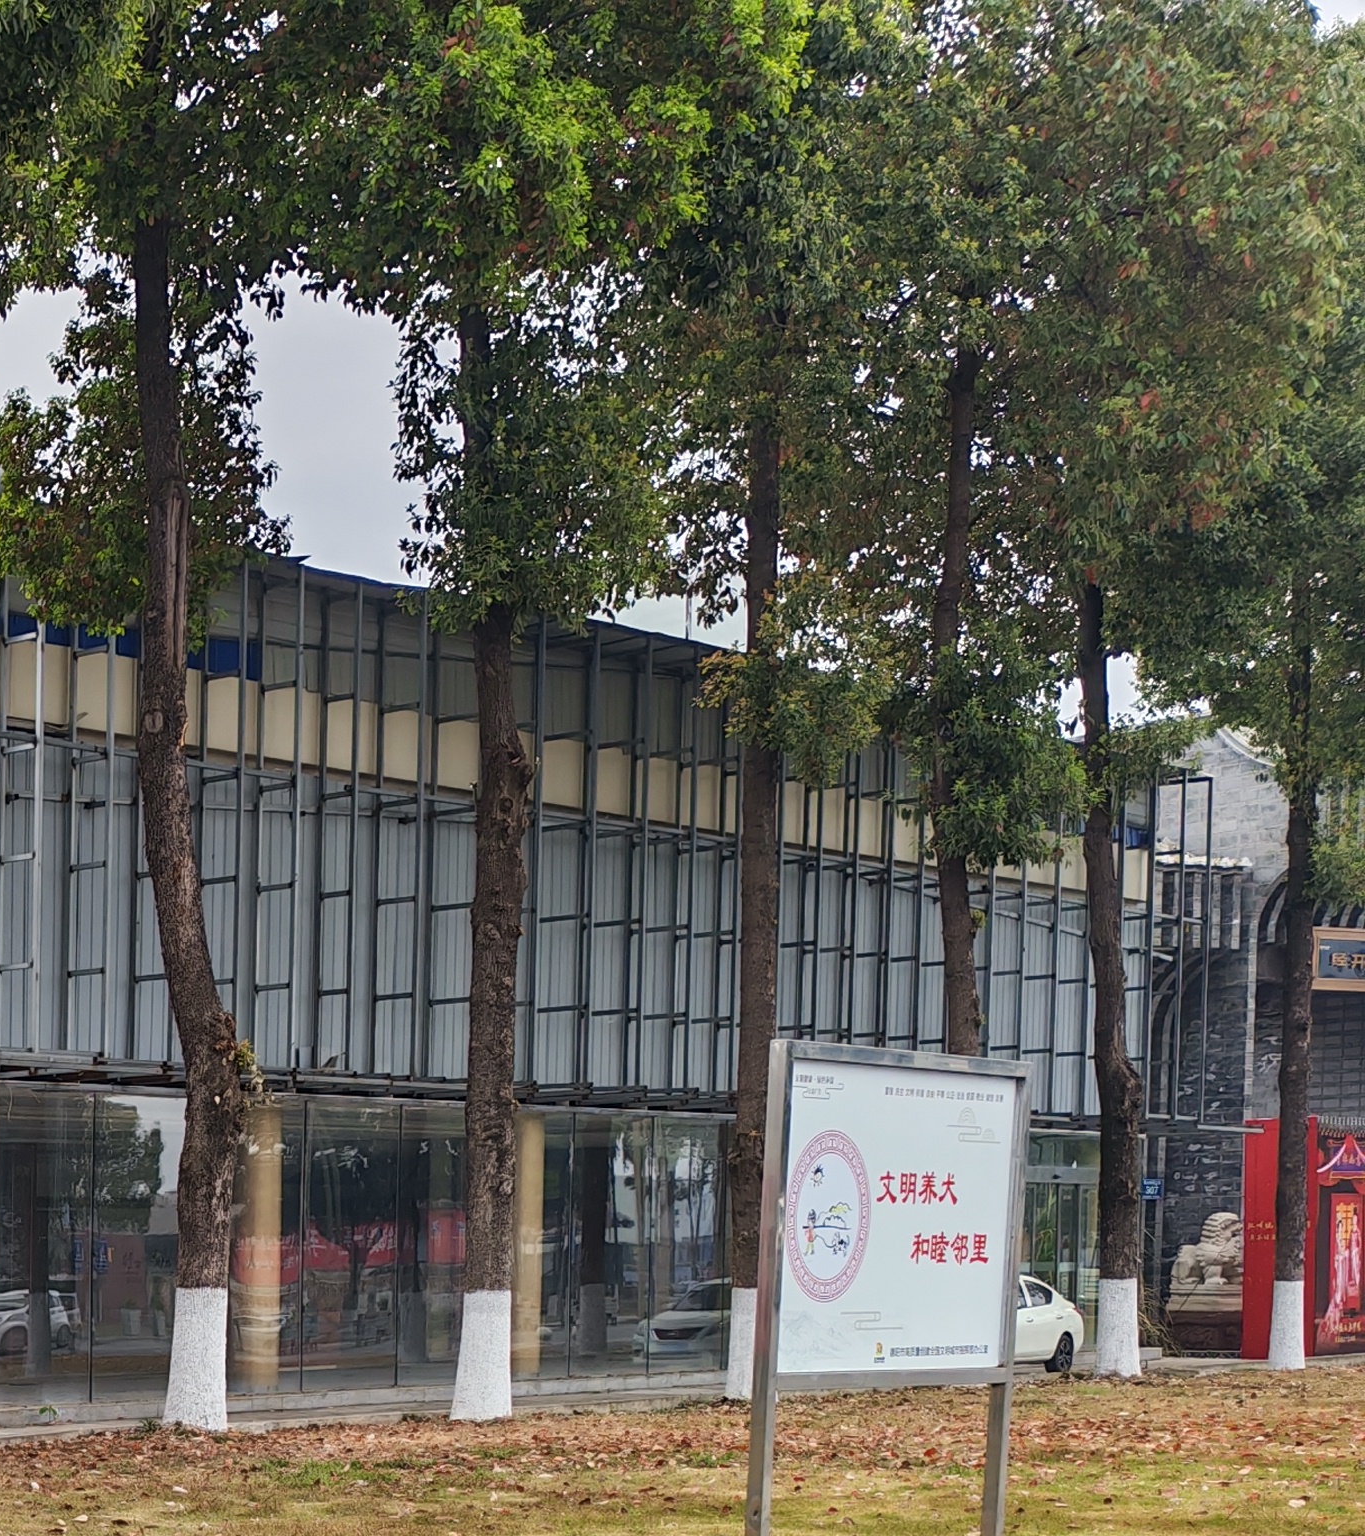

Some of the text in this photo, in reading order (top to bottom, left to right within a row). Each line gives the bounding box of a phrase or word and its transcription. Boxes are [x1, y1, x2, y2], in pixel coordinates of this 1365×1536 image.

[876, 1170, 958, 1205] 文明养犬
[910, 1232, 989, 1266] 和睦邻里
